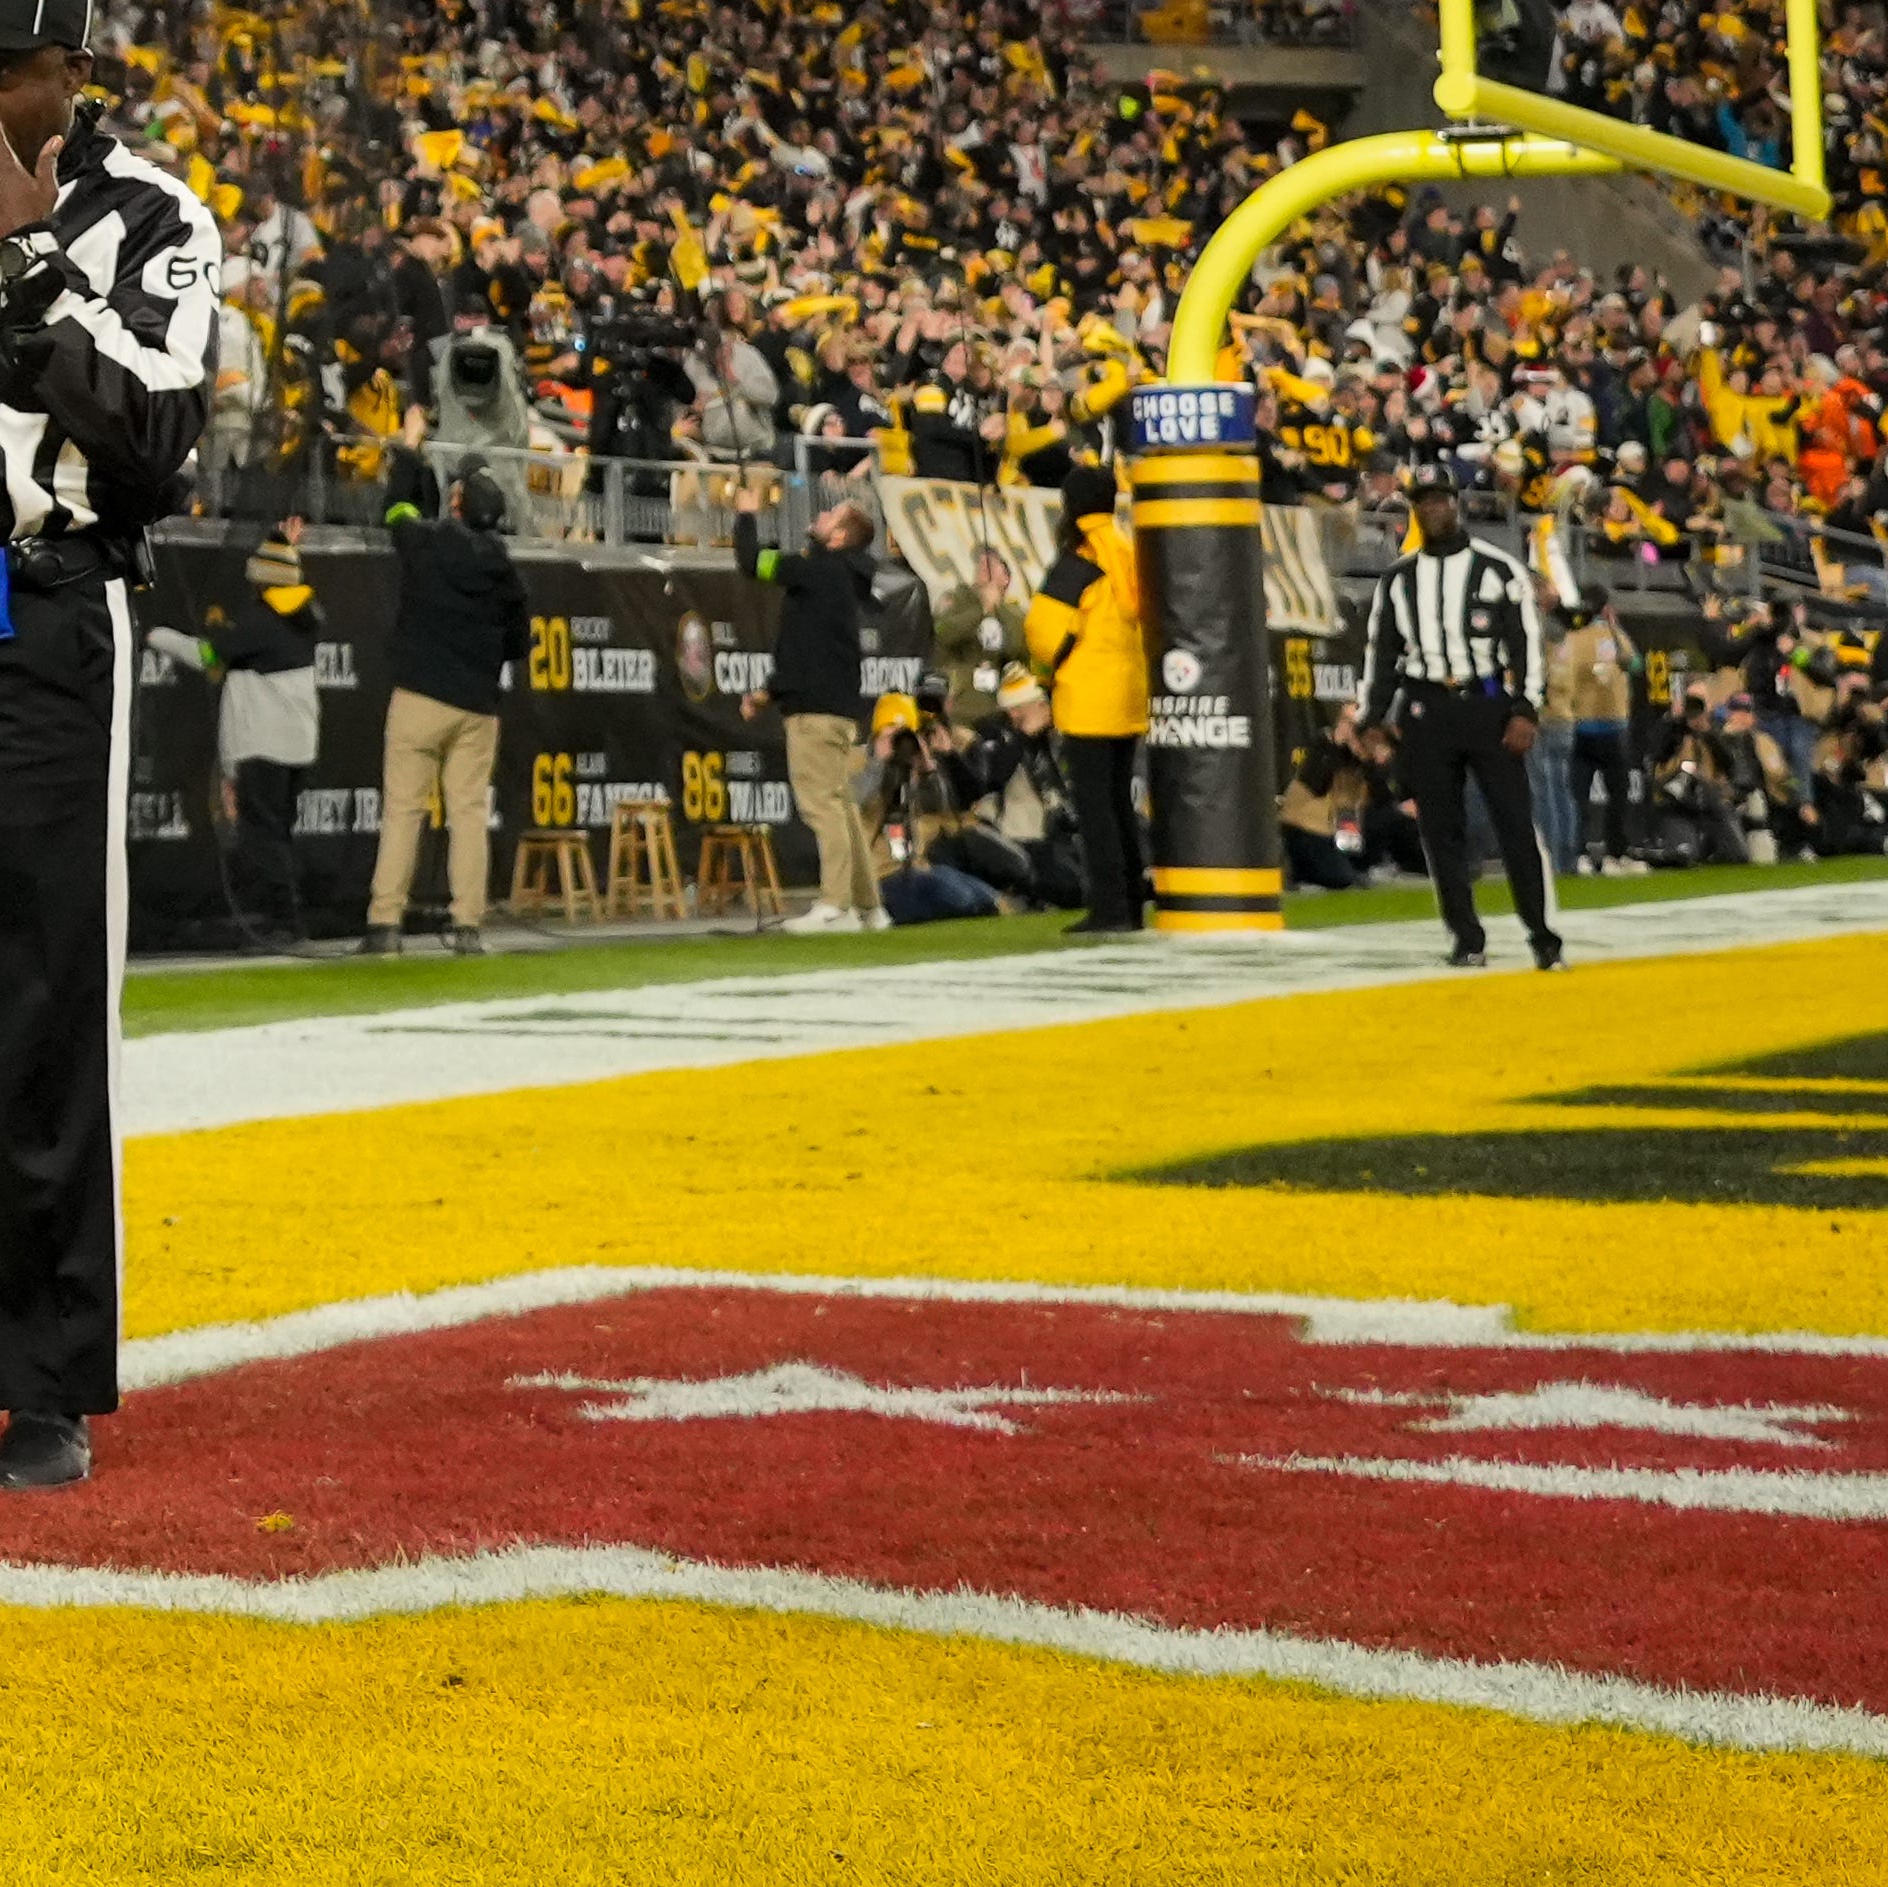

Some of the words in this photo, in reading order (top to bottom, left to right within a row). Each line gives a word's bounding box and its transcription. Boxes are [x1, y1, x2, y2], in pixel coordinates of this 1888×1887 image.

[1132, 392, 1235, 421] CHOOSE
[1145, 415, 1220, 443] LOVE
[530, 615, 571, 692] 20
[1146, 716, 1251, 749] HANGE
[532, 752, 574, 827] 66
[682, 751, 724, 823] 86
